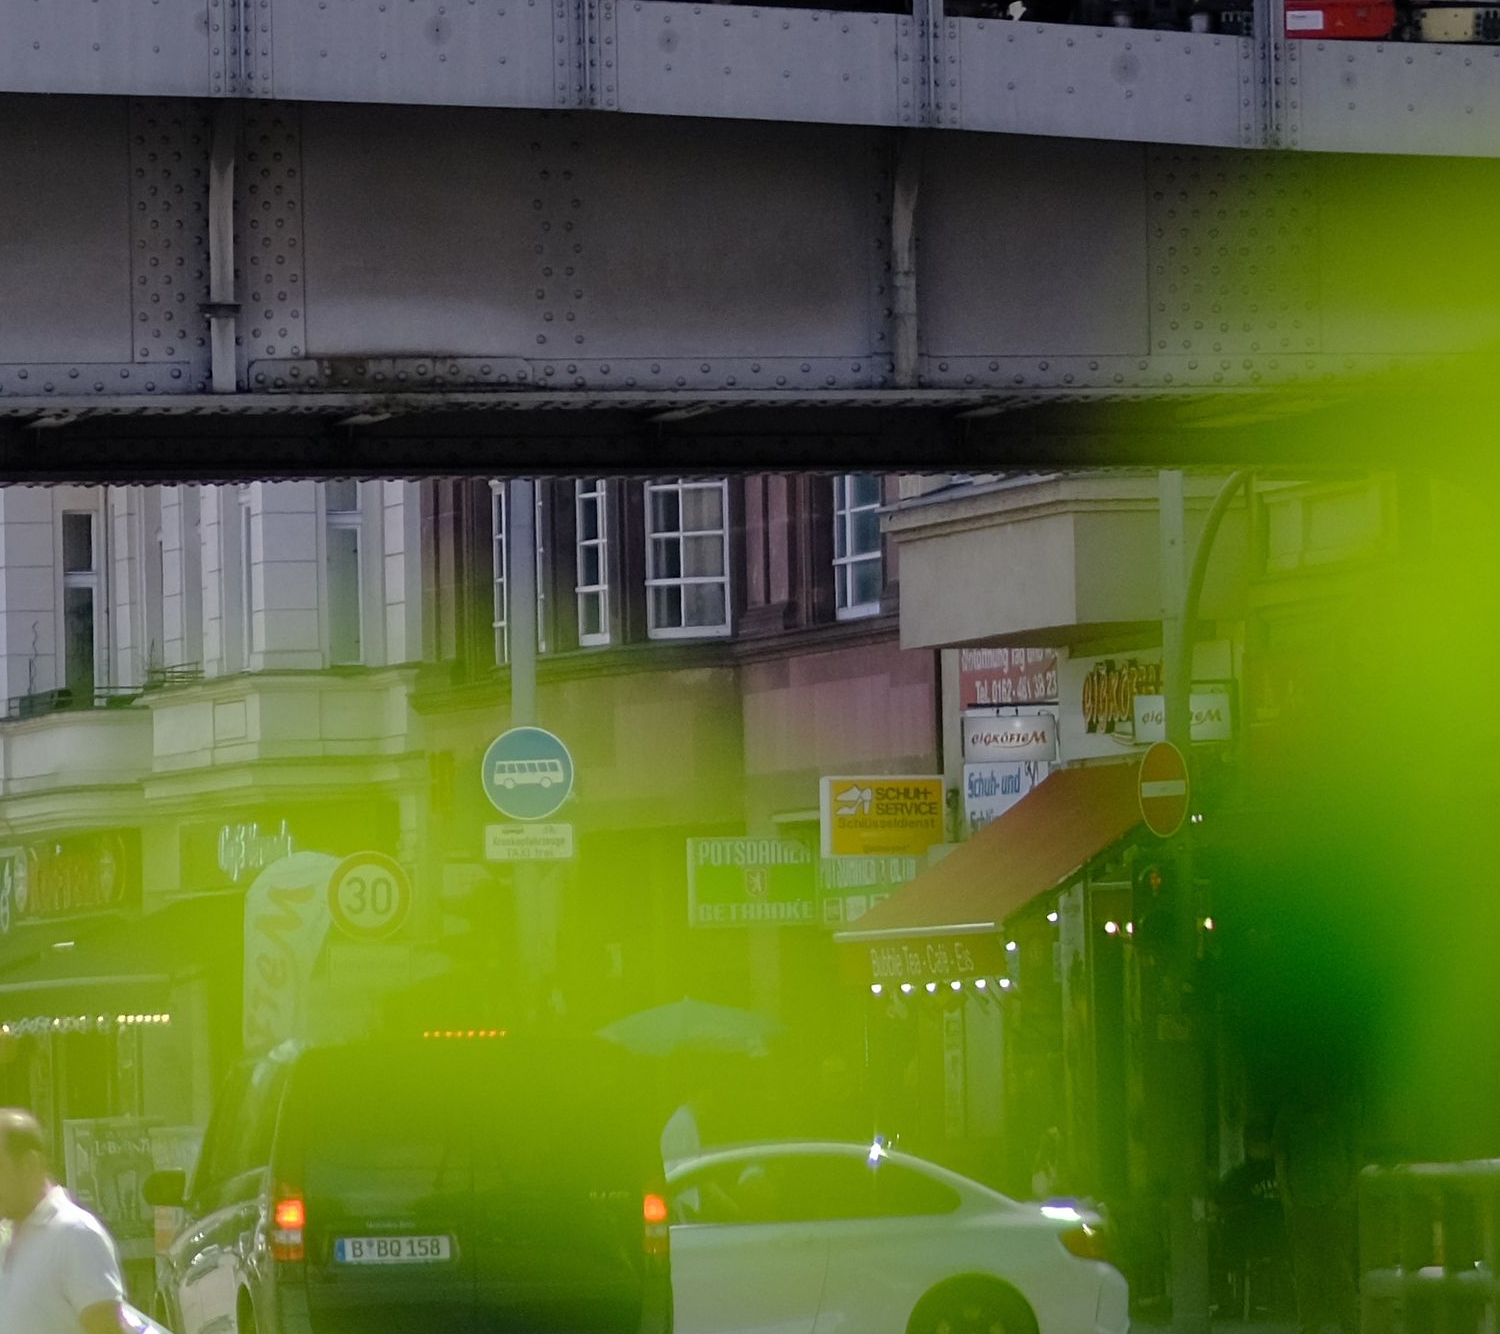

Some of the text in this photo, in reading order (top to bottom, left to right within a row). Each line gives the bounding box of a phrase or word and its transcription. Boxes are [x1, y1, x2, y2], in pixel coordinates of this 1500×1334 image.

[875, 802, 939, 816] SERVICE
[838, 817, 935, 829] Schlüsseldienst
[345, 877, 392, 915] 30
[352, 1241, 363, 1258] B
[406, 1238, 441, 1257] 158
